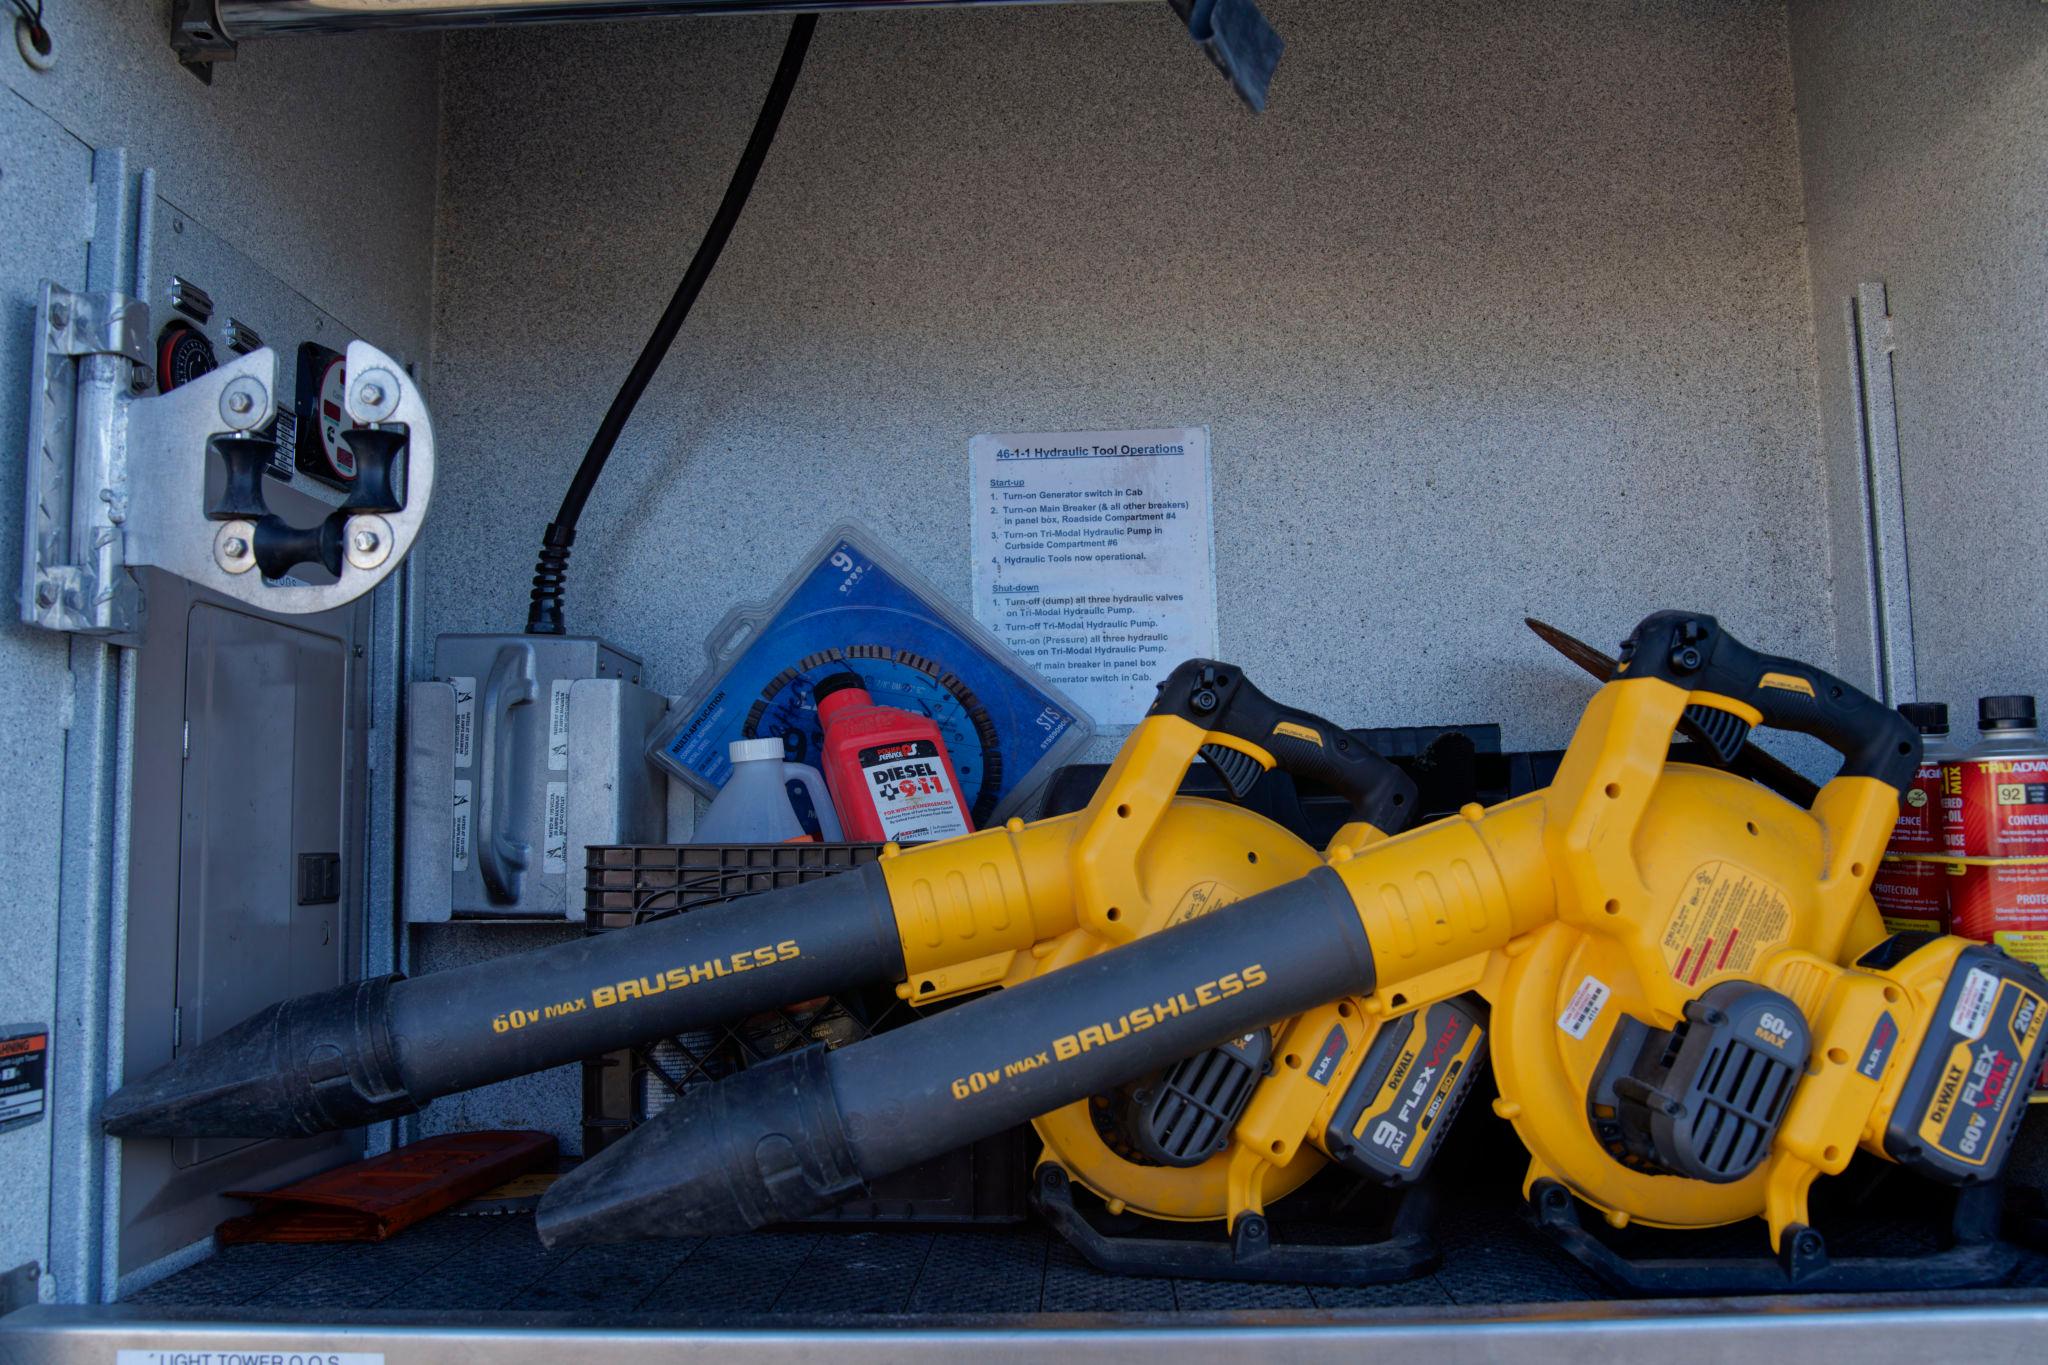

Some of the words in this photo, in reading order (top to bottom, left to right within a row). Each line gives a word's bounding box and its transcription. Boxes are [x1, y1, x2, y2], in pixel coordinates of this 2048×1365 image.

[997, 449, 1030, 458] 46-1-1
[1035, 447, 1088, 458] Hydraulic
[1092, 446, 1117, 455] Tool
[1121, 444, 1183, 456] Operations
[990, 479, 1024, 487] Start-up
[1039, 490, 1083, 498] Generator
[1085, 489, 1113, 497] switch
[1126, 488, 1142, 496] Cab
[1003, 506, 1037, 514] Turn-on
[1063, 504, 1096, 512] Breaker
[1099, 504, 1107, 512] (&
[1123, 502, 1146, 510] other
[1148, 501, 1189, 510] breakers)
[1015, 516, 1038, 526] panel
[1041, 515, 1059, 524] box,
[1062, 514, 1102, 523] Roadside
[1105, 513, 1164, 523] Compartment
[1004, 531, 1038, 539] Turn-on
[1041, 529, 1080, 538] Tri-Modal
[1083, 528, 1124, 538] Hydraulic
[1127, 527, 1152, 536] Pump
[1005, 541, 1044, 549] Curbside
[1047, 539, 1105, 549] Compartment
[1005, 557, 1045, 565] Hydraulic
[1095, 553, 1147, 562] operational.
[993, 584, 1039, 592] Shut-down
[1006, 598, 1040, 606] Turn-off
[1042, 597, 1073, 606] (dump)
[1113, 594, 1153, 603] hydraulic
[1021, 608, 1061, 617] Tri-Modal
[1064, 607, 1105, 616] Hydraulic
[1107, 606, 1135, 616] Pump.
[1006, 623, 1040, 631] Turn-off
[1043, 621, 1084, 630] Tri-Modal
[1086, 620, 1127, 630] Hydraulic
[1130, 620, 1157, 629] Pump.
[1007, 637, 1040, 645] Turn-on
[1043, 636, 1088, 645] (Pressure)
[1102, 634, 1125, 642] three
[1128, 633, 1168, 642] hydraulic
[1052, 646, 1092, 655] Tri-Modal
[1095, 645, 1136, 654] Hydraulic
[1139, 644, 1166, 653] Pump.
[1114, 660, 1137, 669] panel
[1132, 673, 1151, 681] Cab.
[671, 691, 726, 754] MULTI-APPLICATION
[1035, 705, 1061, 732] STS
[873, 763, 937, 784] DIESEL
[1950, 766, 1962, 794] MIX
[2002, 788, 2021, 801] 92
[1948, 810, 1963, 822] OIL
[1951, 834, 1965, 847] USE
[1875, 883, 1919, 896] PROTECTION
[545, 998, 586, 1019] MAX
[592, 940, 800, 1009] BRUSHLESS
[1004, 1052, 1050, 1078] MAX
[1052, 964, 1267, 1061] BRUSHLESS
[1755, 1027, 1786, 1050] MAX
[1962, 1044, 1999, 1107] FLEX
[1976, 1051, 2013, 1109] VOLT
[1373, 1121, 1399, 1148] 9
[1391, 1131, 1407, 1154] AH
